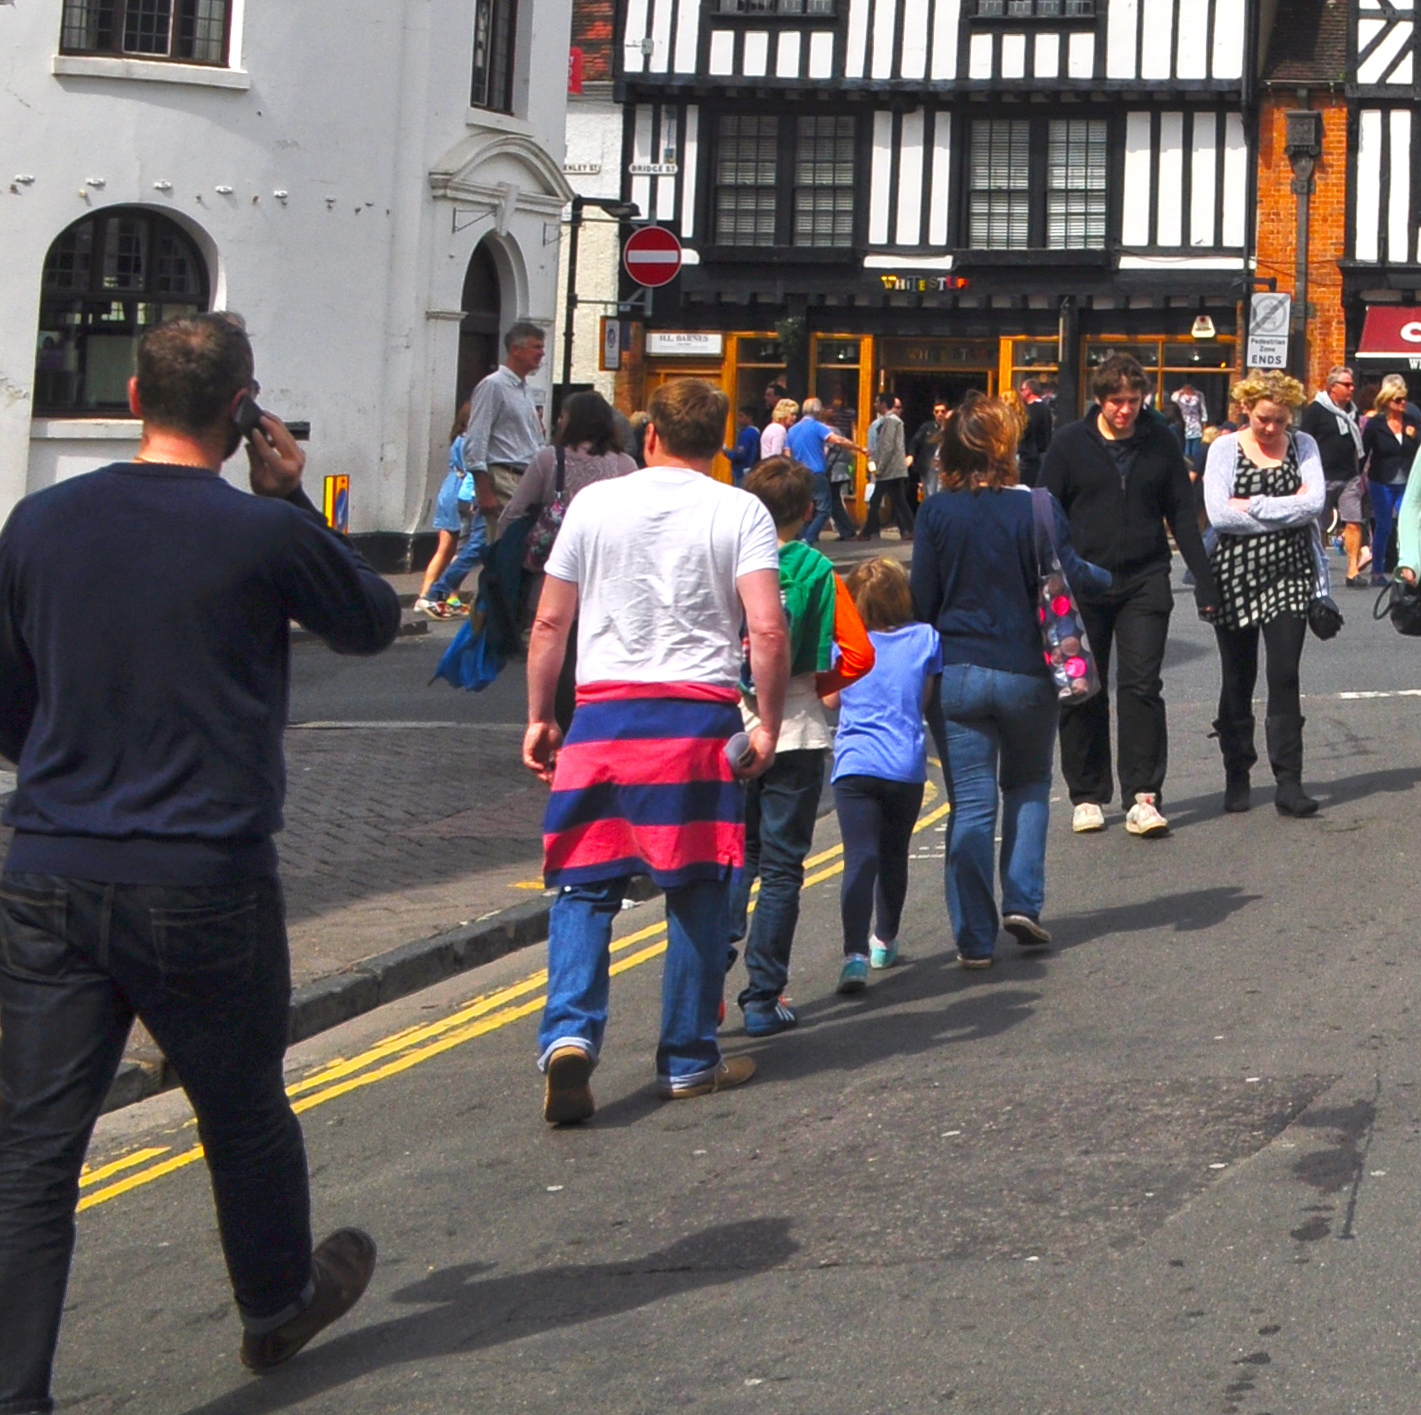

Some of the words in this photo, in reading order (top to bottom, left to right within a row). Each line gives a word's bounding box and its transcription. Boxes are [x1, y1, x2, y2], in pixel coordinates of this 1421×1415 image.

[562, 164, 587, 172] ENLEY
[631, 165, 663, 173] BRIDGE
[881, 275, 926, 292] WHITE
[1251, 354, 1282, 365] ENDS
